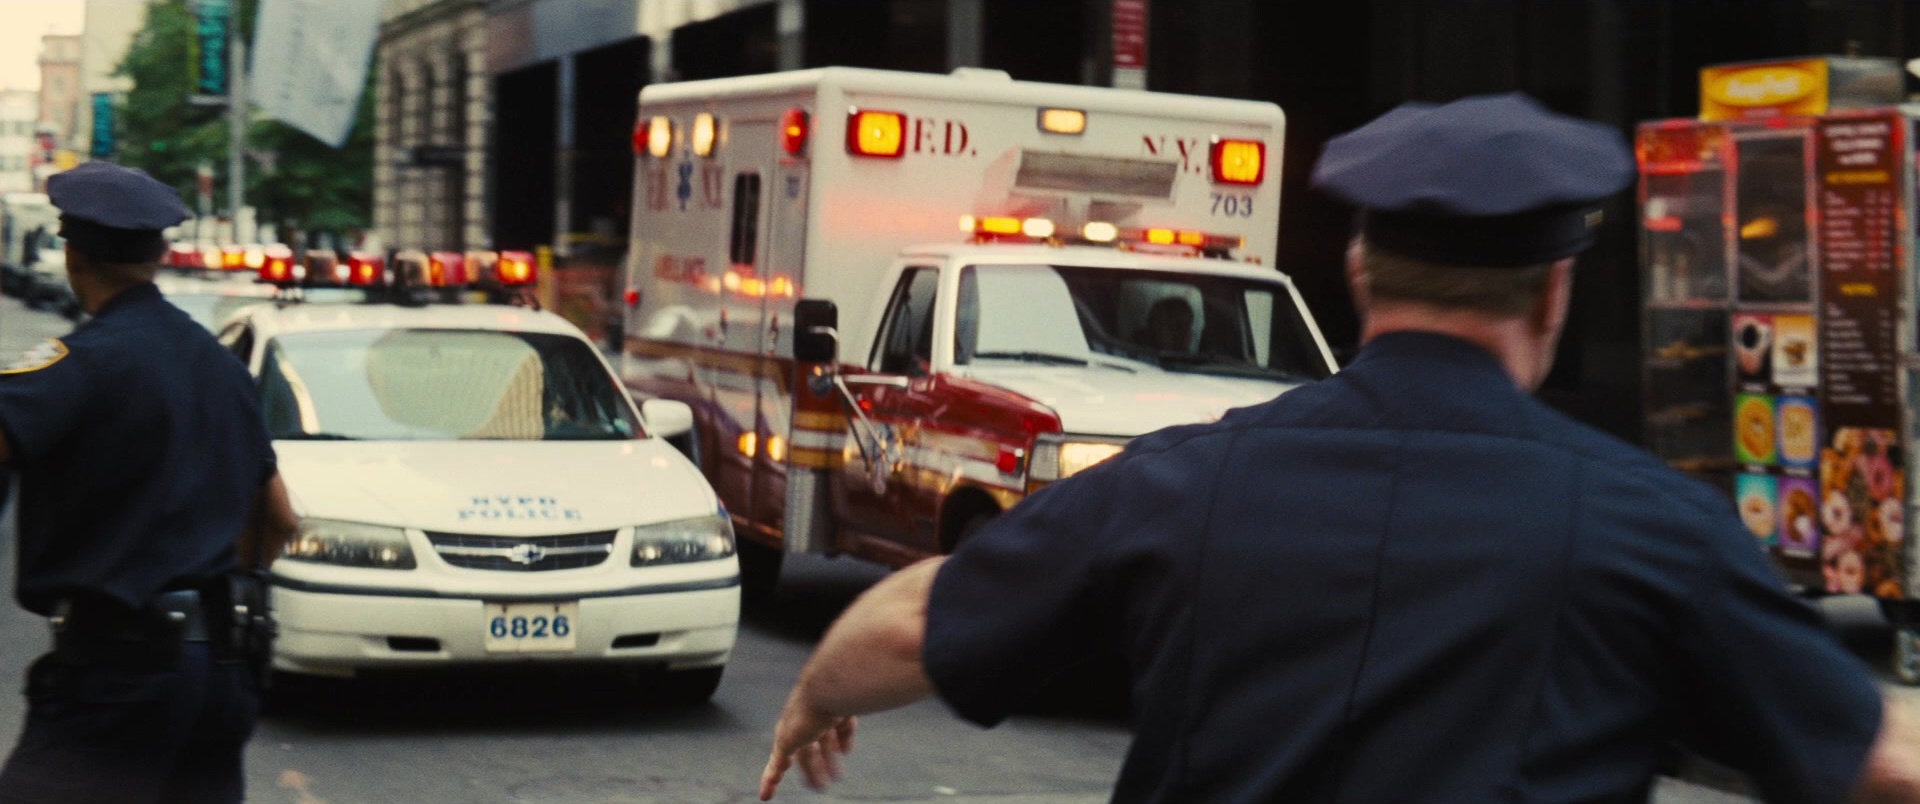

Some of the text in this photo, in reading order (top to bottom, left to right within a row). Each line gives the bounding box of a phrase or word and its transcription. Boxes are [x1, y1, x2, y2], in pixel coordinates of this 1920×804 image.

[914, 117, 977, 156] F.D.
[1210, 193, 1253, 218] 703
[471, 495, 557, 506] NYPD
[458, 507, 583, 521] POLICE
[489, 616, 571, 639] 6826
